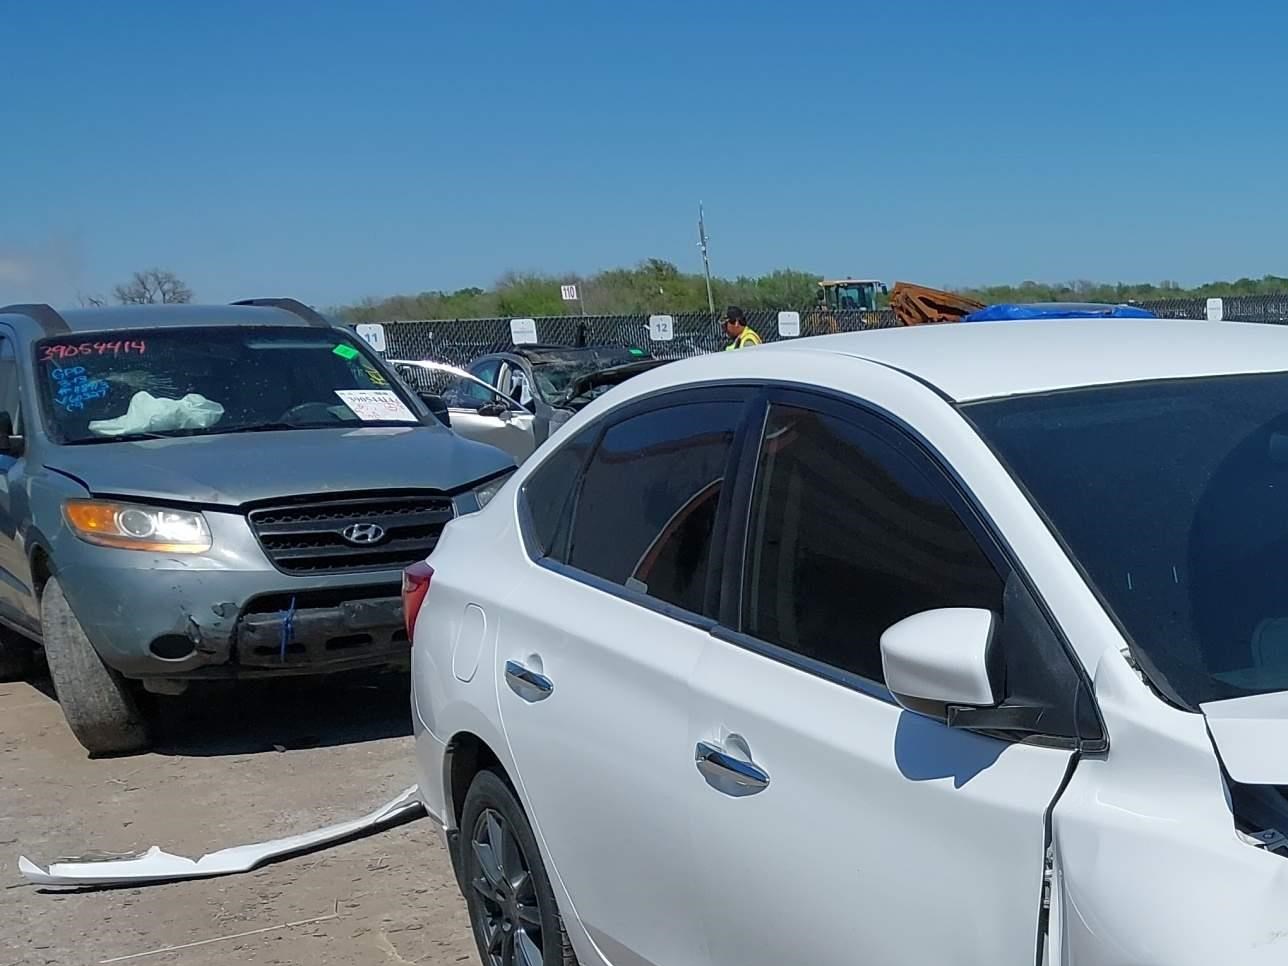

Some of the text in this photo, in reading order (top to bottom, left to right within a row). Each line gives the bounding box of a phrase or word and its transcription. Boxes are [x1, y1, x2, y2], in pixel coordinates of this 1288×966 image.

[563, 286, 575, 298] 110
[656, 323, 668, 333] 12
[364, 333, 378, 343] 11
